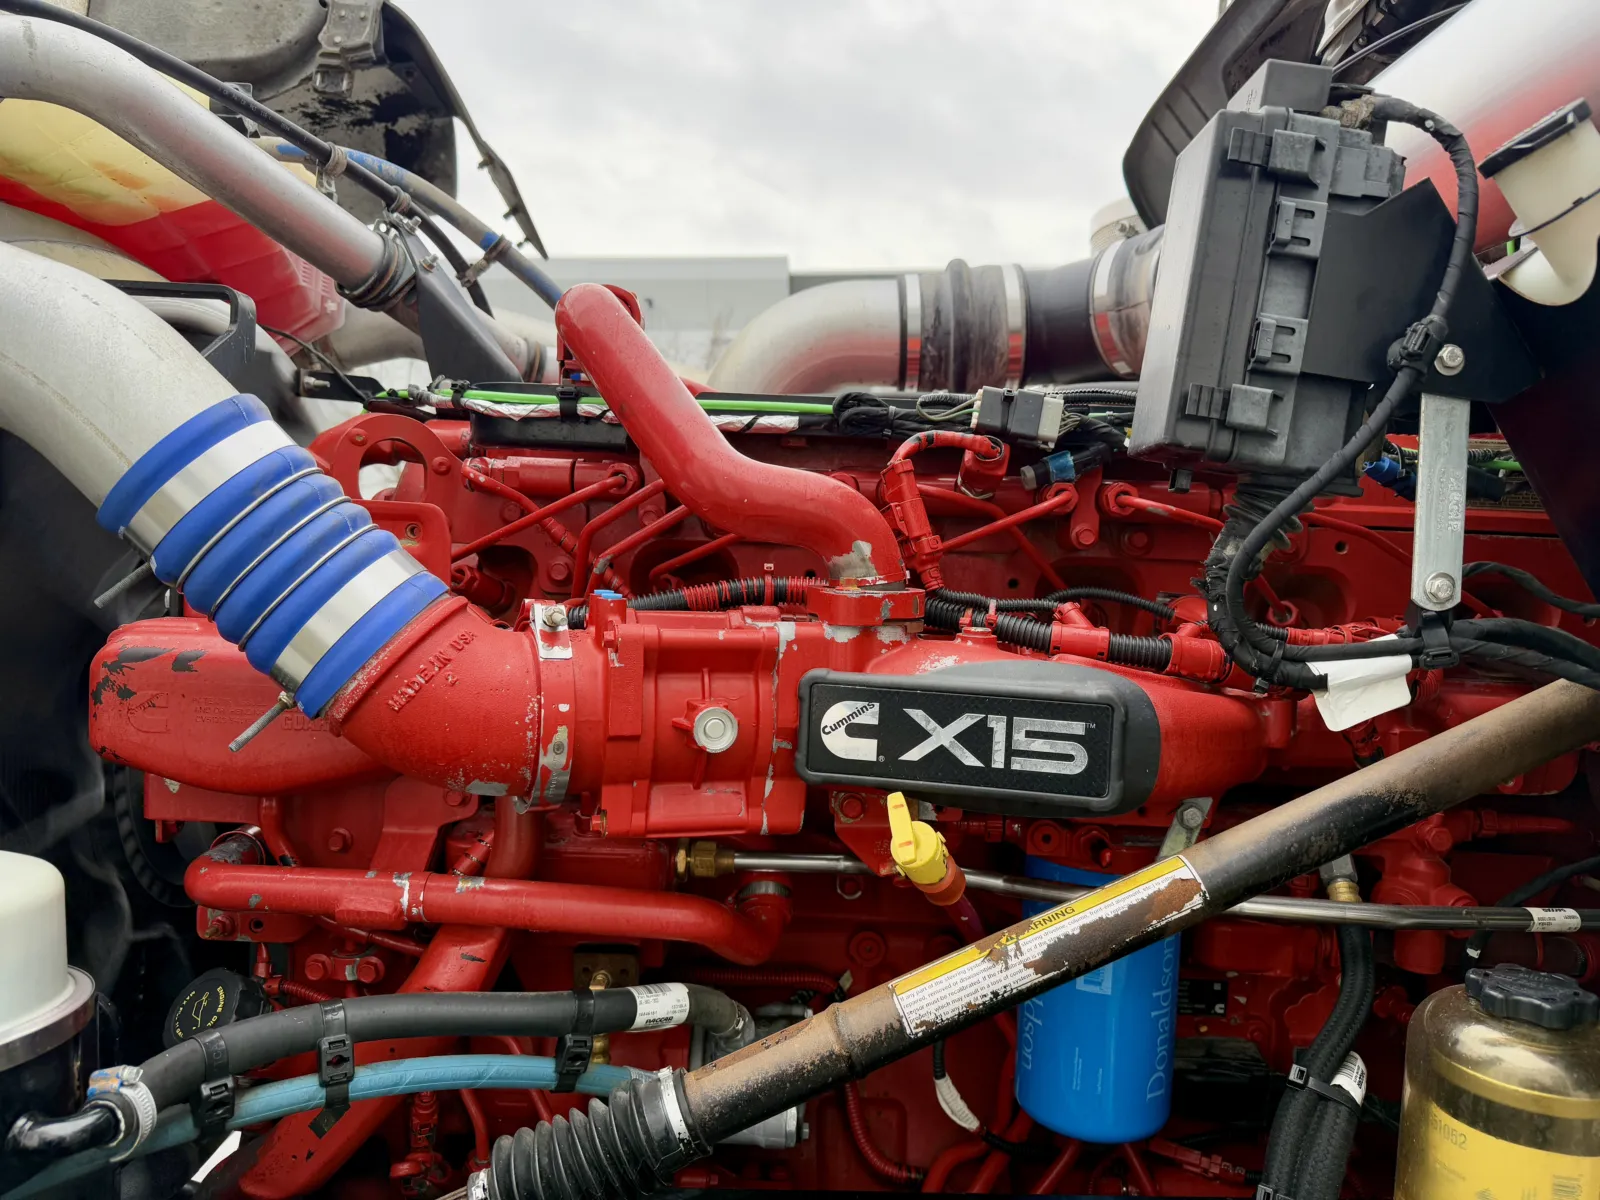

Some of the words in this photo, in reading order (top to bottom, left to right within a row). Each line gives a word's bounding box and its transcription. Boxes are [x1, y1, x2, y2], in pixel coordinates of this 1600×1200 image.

[387, 667, 435, 713] MADE
[429, 650, 453, 671] IN
[450, 631, 478, 651] USA
[822, 702, 875, 735] Cummins
[933, 978, 943, 986] the
[216, 986, 225, 1012] ENGINE
[207, 1015, 217, 1027] OIL
